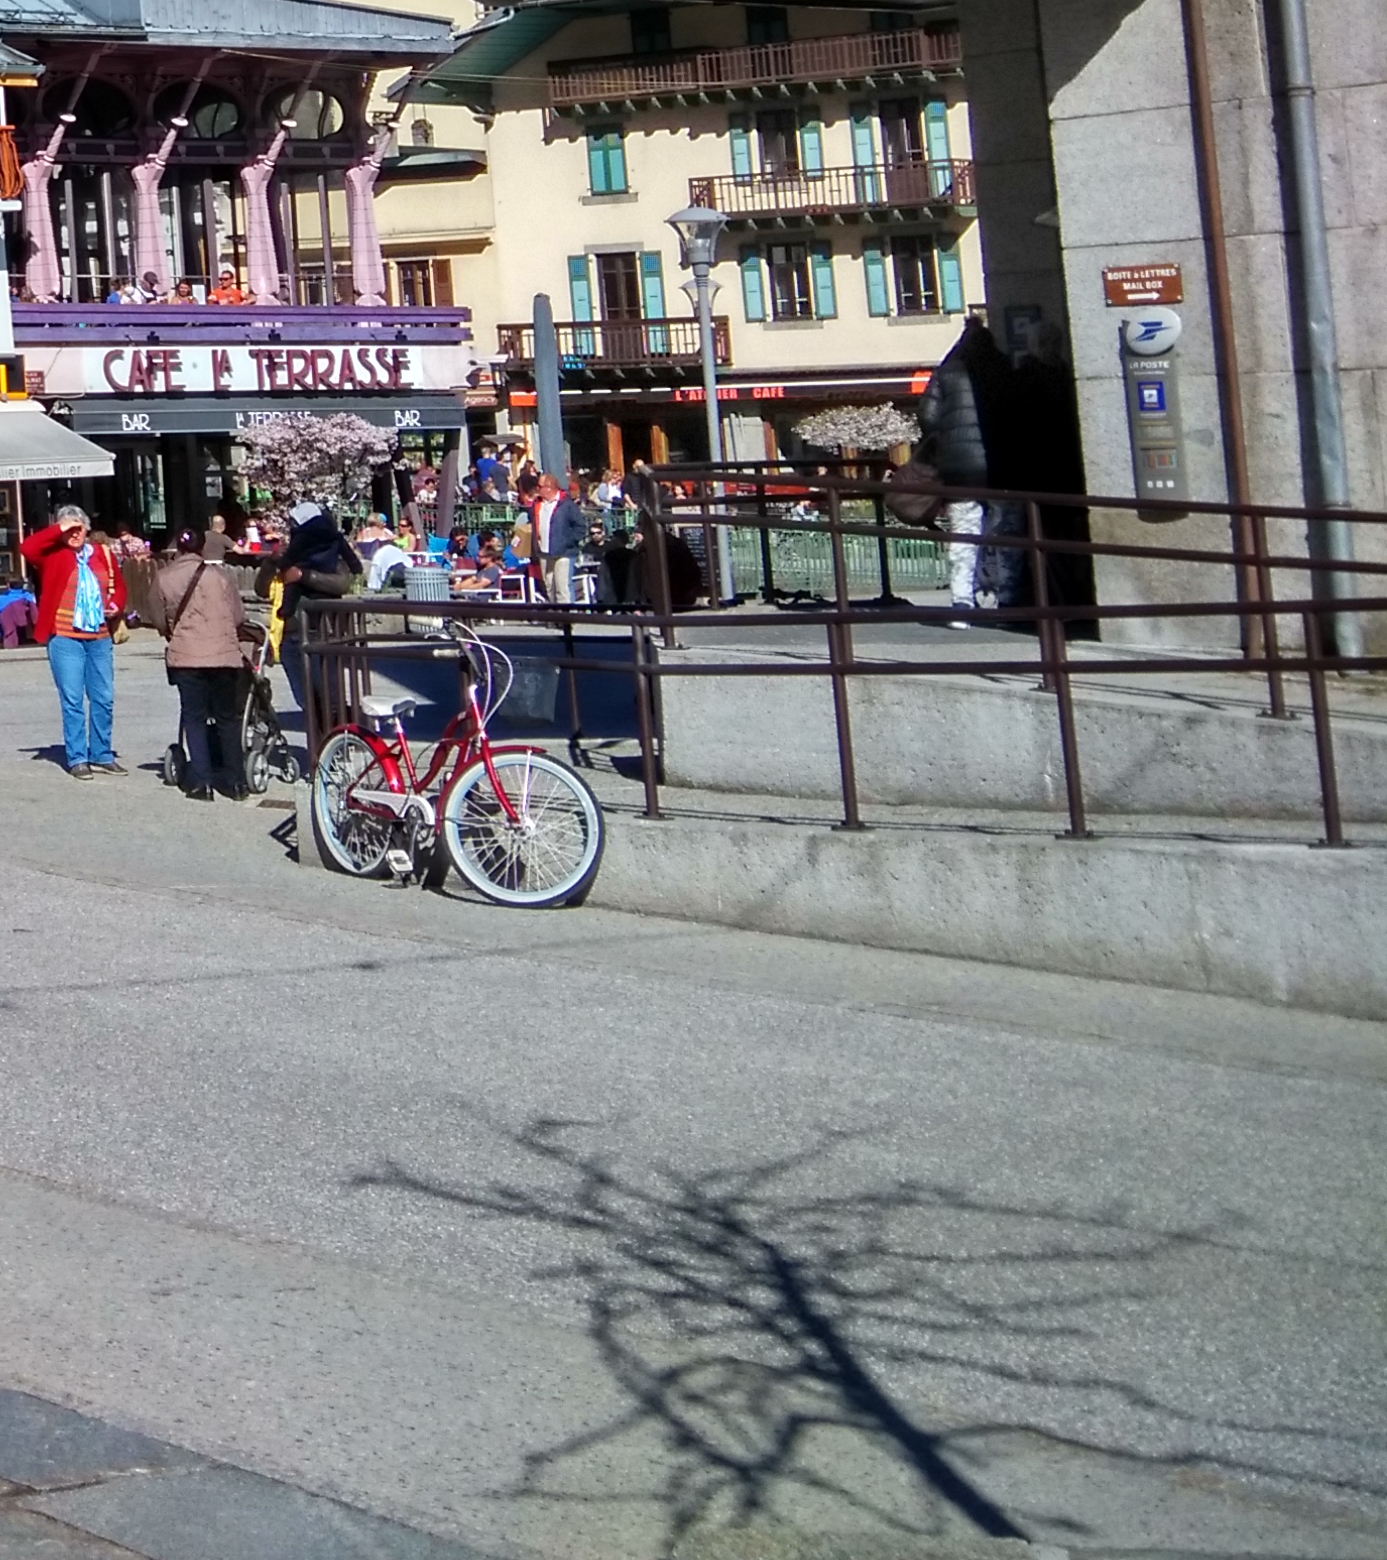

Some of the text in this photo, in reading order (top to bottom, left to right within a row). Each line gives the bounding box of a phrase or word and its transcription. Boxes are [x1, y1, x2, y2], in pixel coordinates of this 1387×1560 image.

[1122, 280, 1164, 290] MAIL BOX
[249, 347, 414, 391] TERRASSE
[1140, 360, 1170, 370] POSTE
[675, 389, 738, 401] L'ATIER
[122, 413, 151, 431] BAR
[394, 410, 422, 428] BAR
